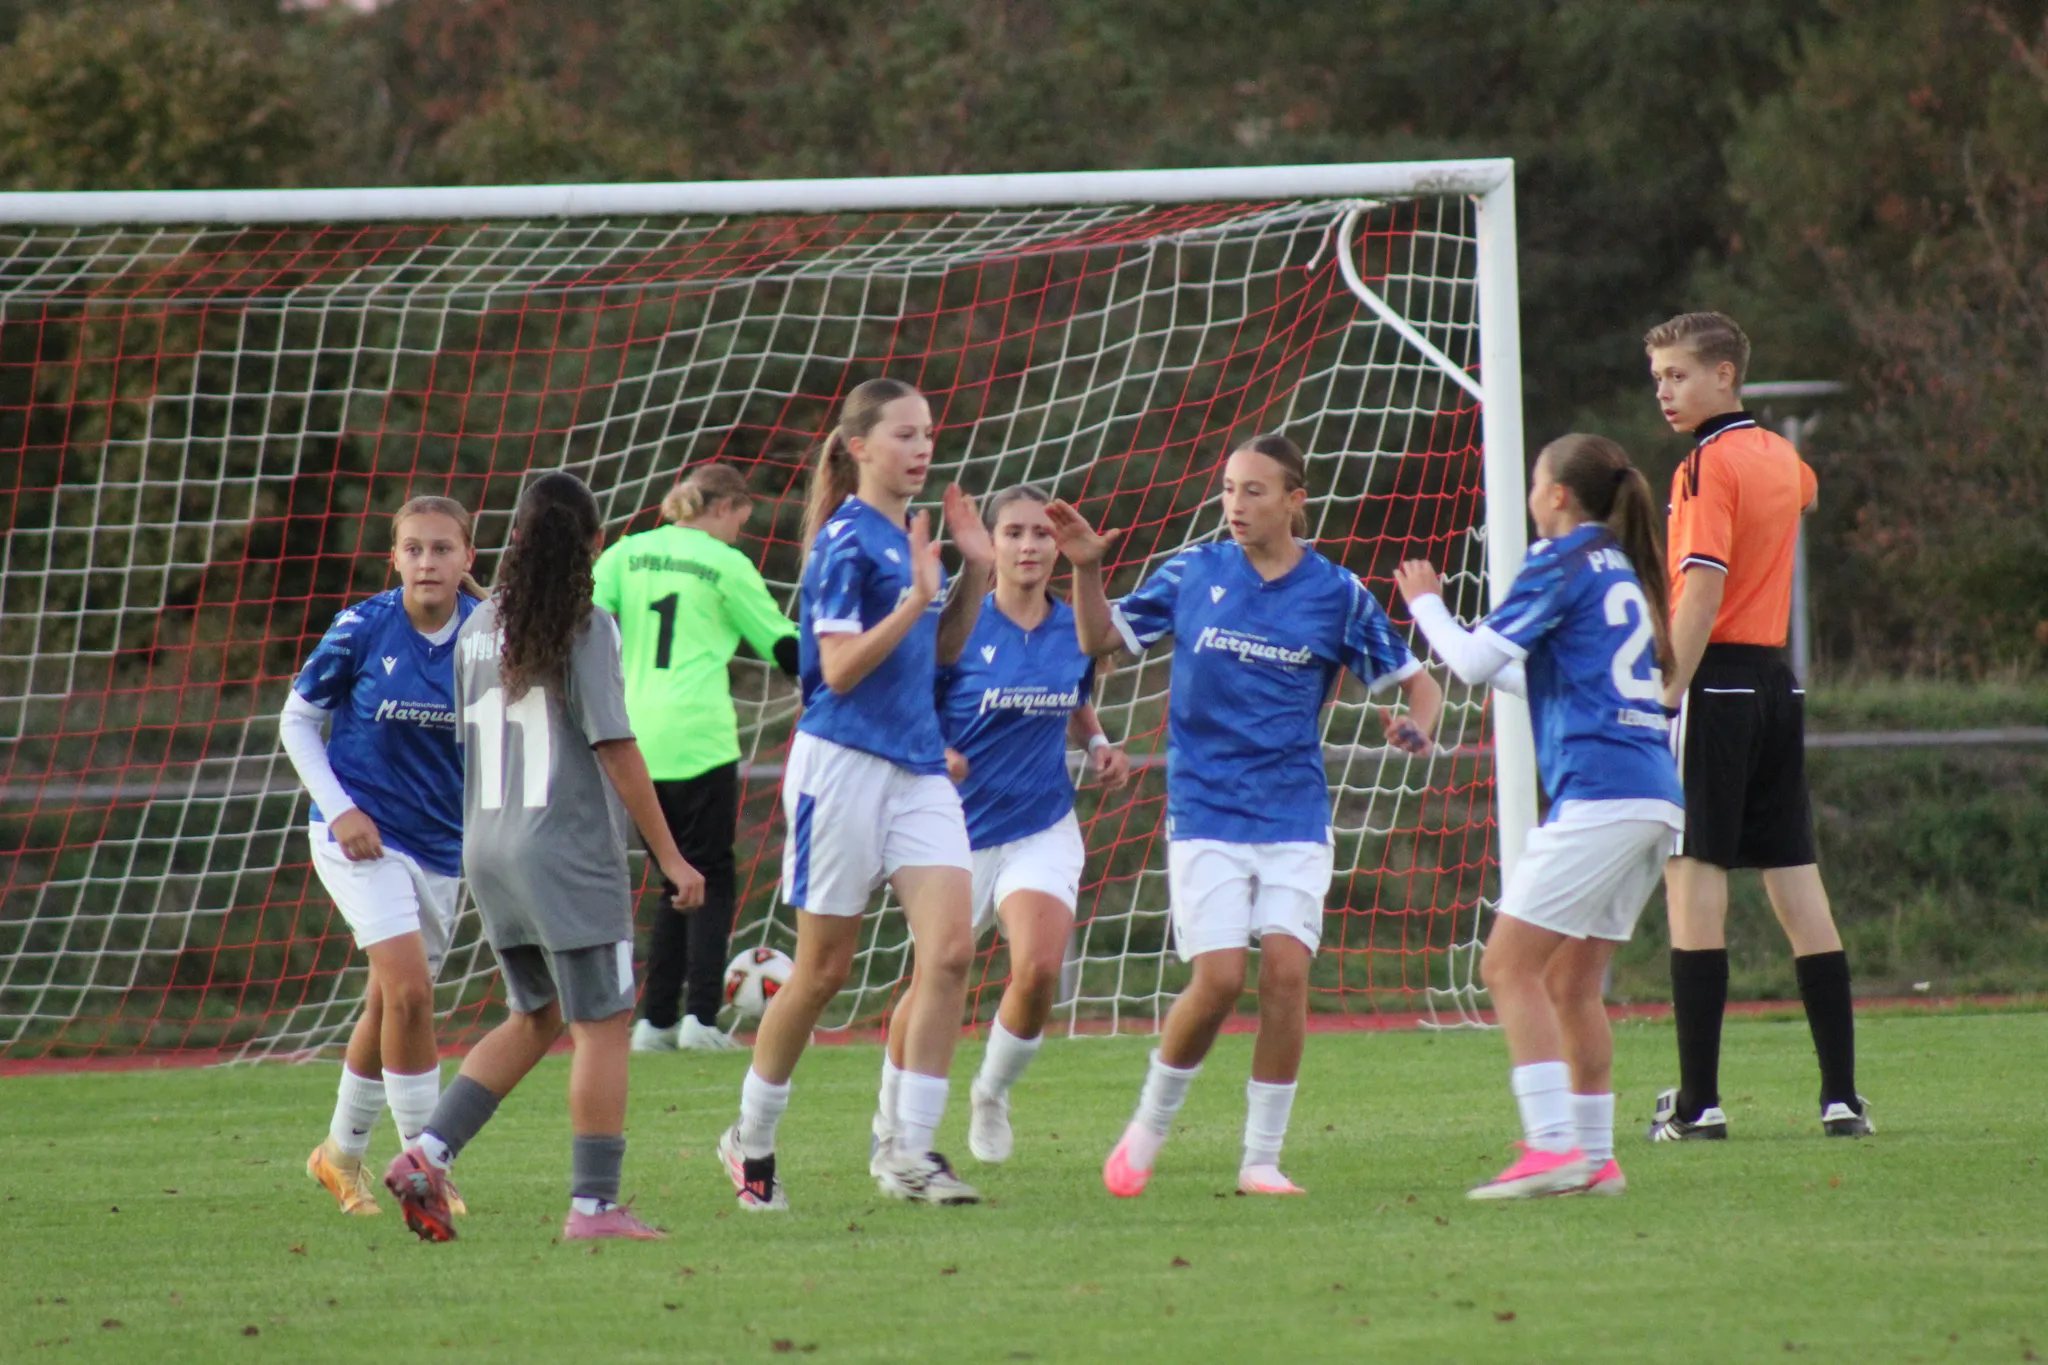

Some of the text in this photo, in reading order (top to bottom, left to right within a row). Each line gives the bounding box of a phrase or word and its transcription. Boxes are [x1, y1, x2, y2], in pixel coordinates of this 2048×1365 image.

[648, 592, 678, 669] 1
[1603, 581, 1665, 699] 2
[374, 699, 457, 728] Marqua
[980, 684, 1079, 716] Marquard
[464, 686, 550, 809] 11
